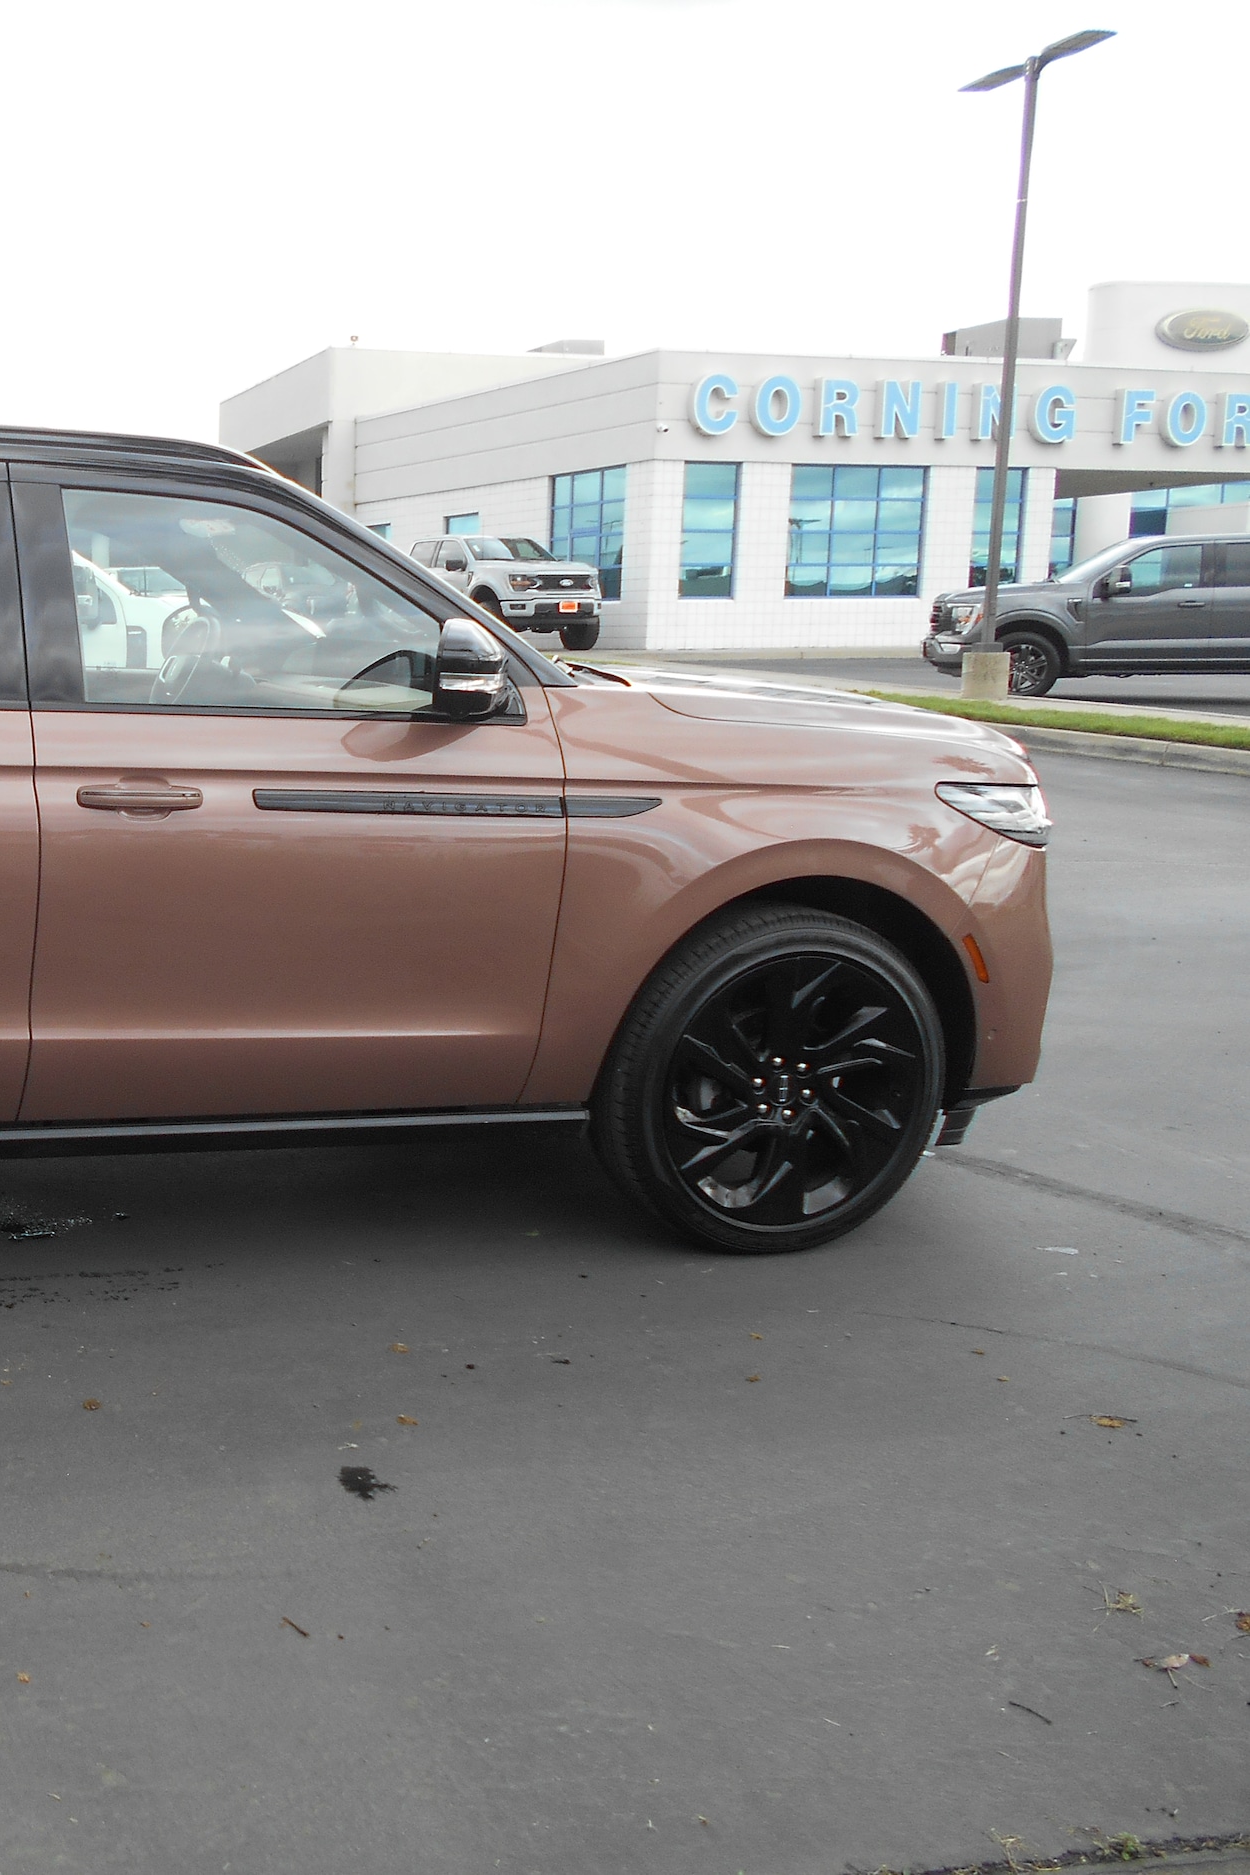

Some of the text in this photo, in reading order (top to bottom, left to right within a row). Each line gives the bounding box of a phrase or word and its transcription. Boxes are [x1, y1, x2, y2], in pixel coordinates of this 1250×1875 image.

[1183, 317, 1231, 340] Ford
[689, 373, 1077, 445] CORNING
[383, 800, 546, 814] NAVIGATOR
